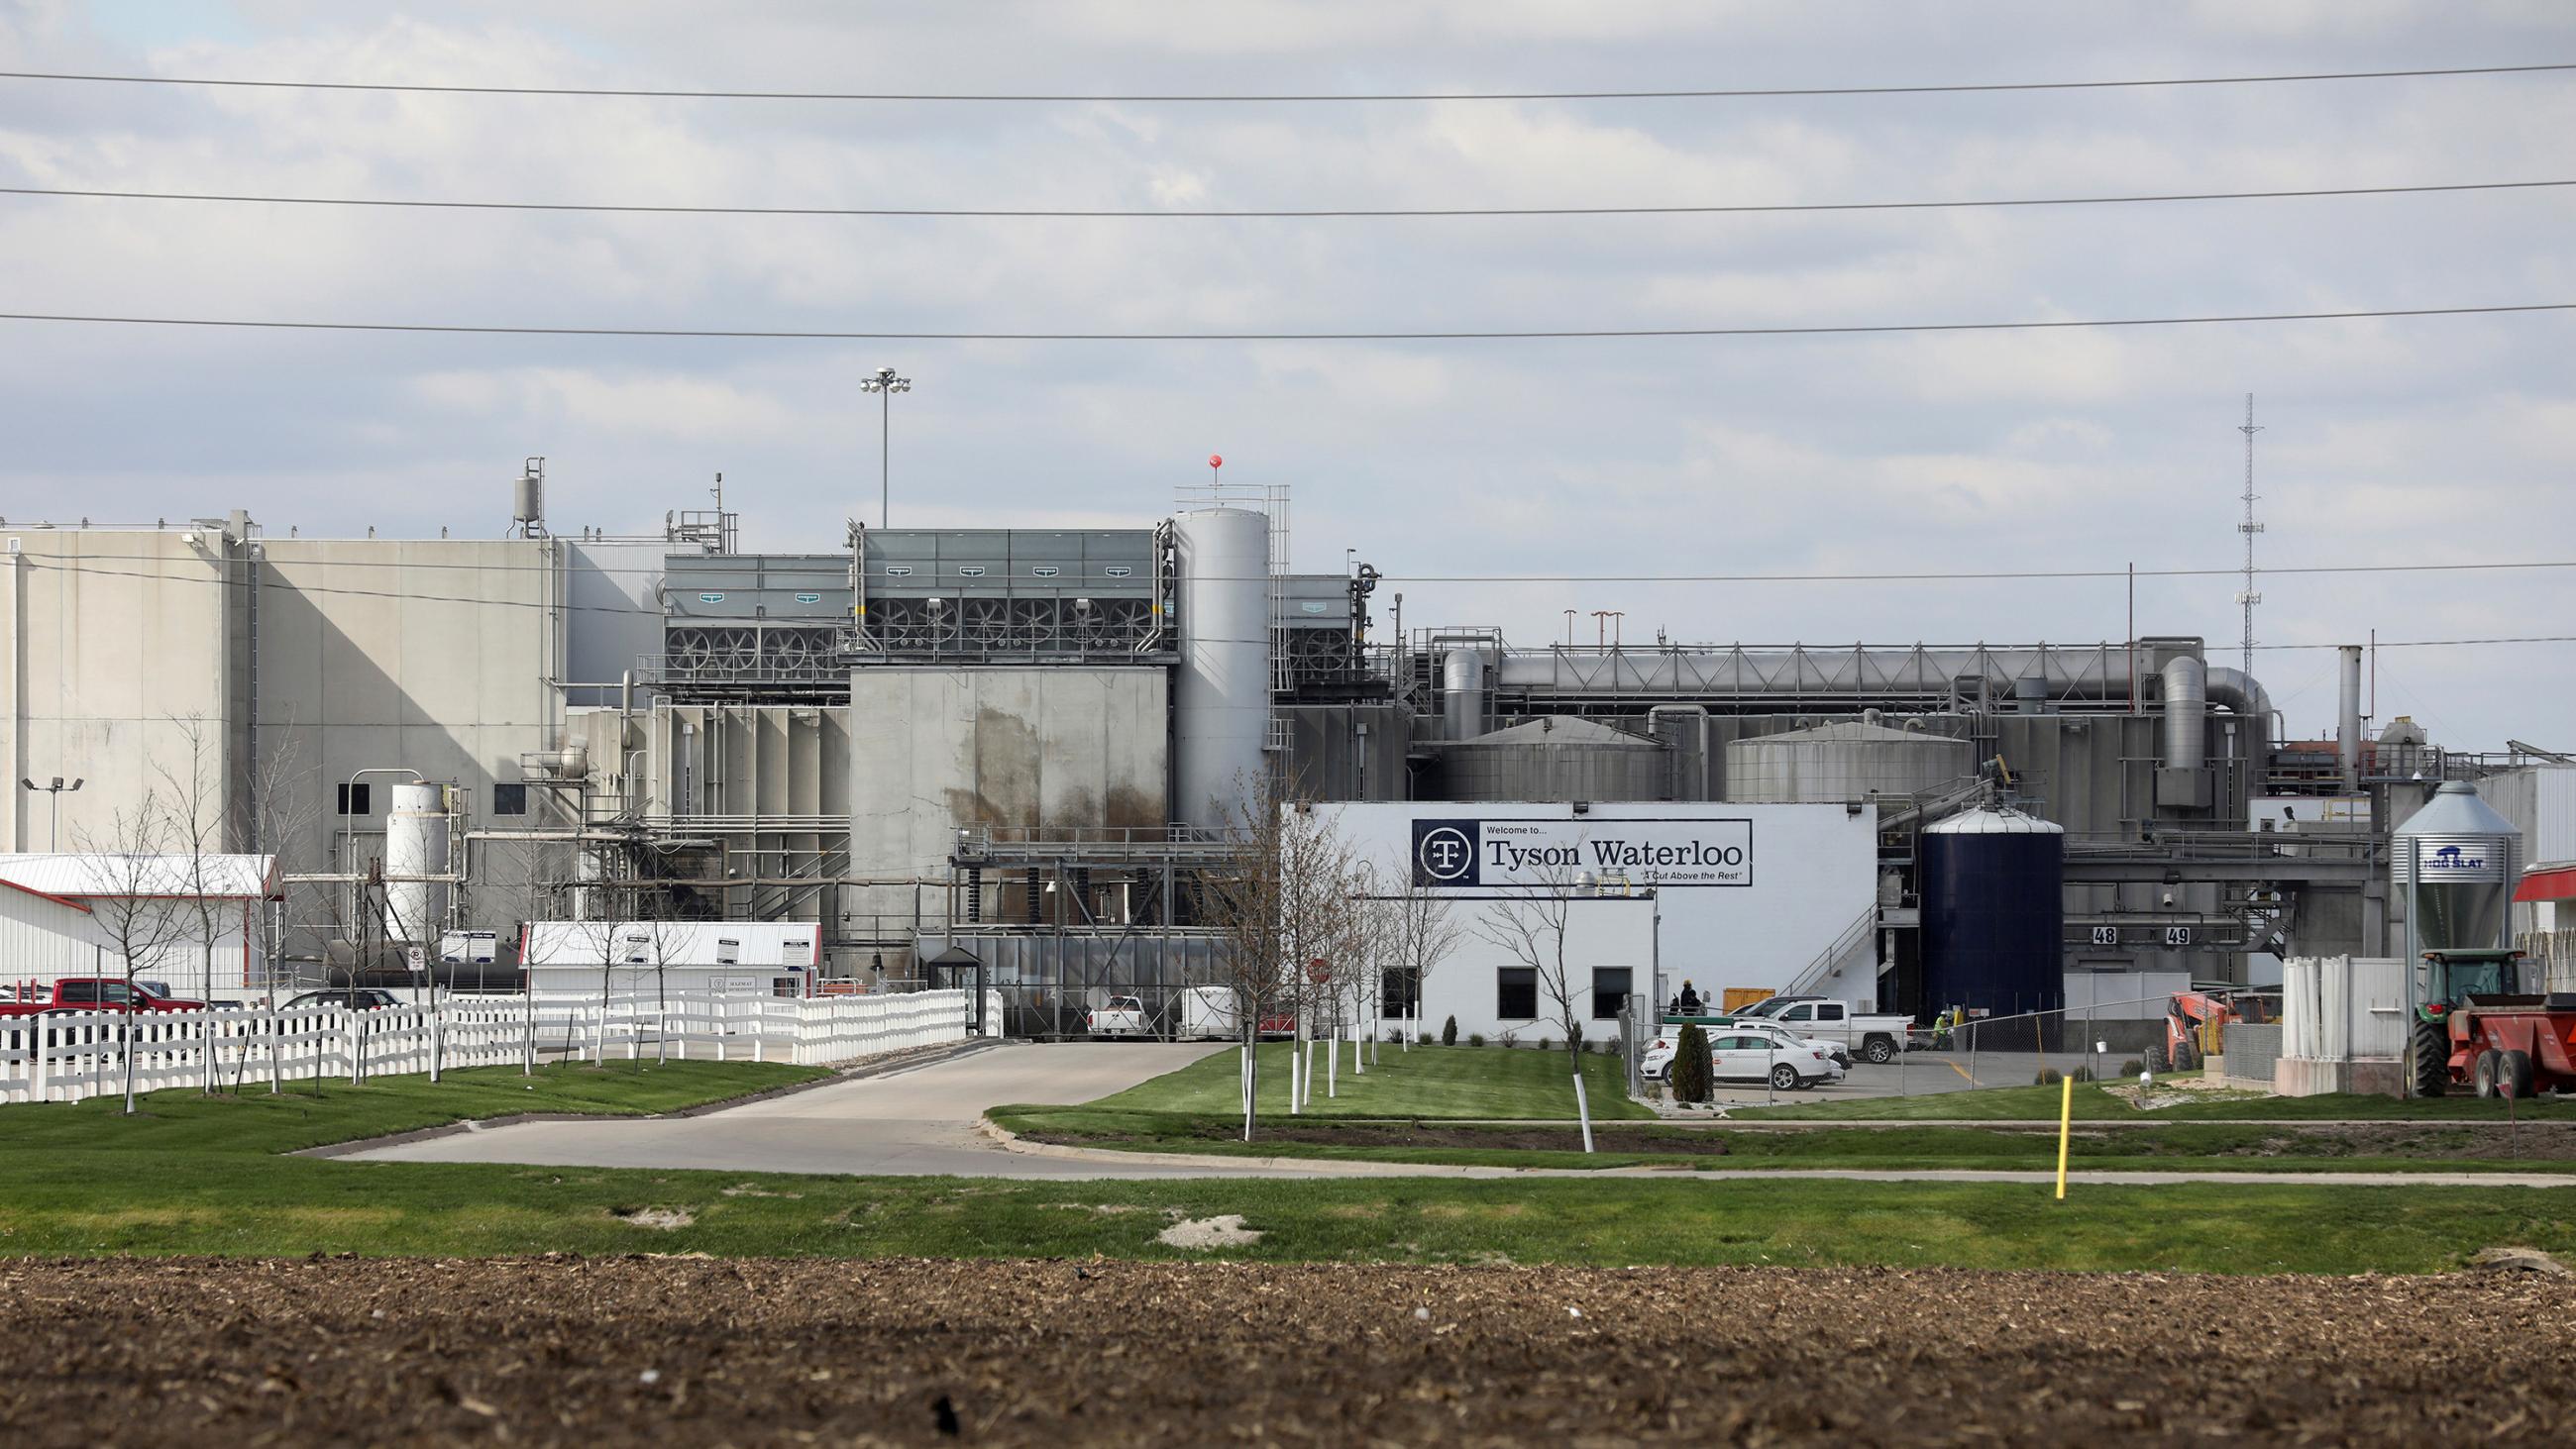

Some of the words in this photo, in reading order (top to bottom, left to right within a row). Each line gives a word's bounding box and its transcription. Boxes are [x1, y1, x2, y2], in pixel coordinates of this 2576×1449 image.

[1487, 826, 1527, 835] Welcome
[1486, 841, 1581, 872] Tyson
[1590, 840, 1743, 866] Waterloo
[1669, 872, 1699, 880] Above
[1701, 872, 1715, 880] the
[2094, 928, 2115, 944] 48
[2168, 928, 2189, 944] 49
